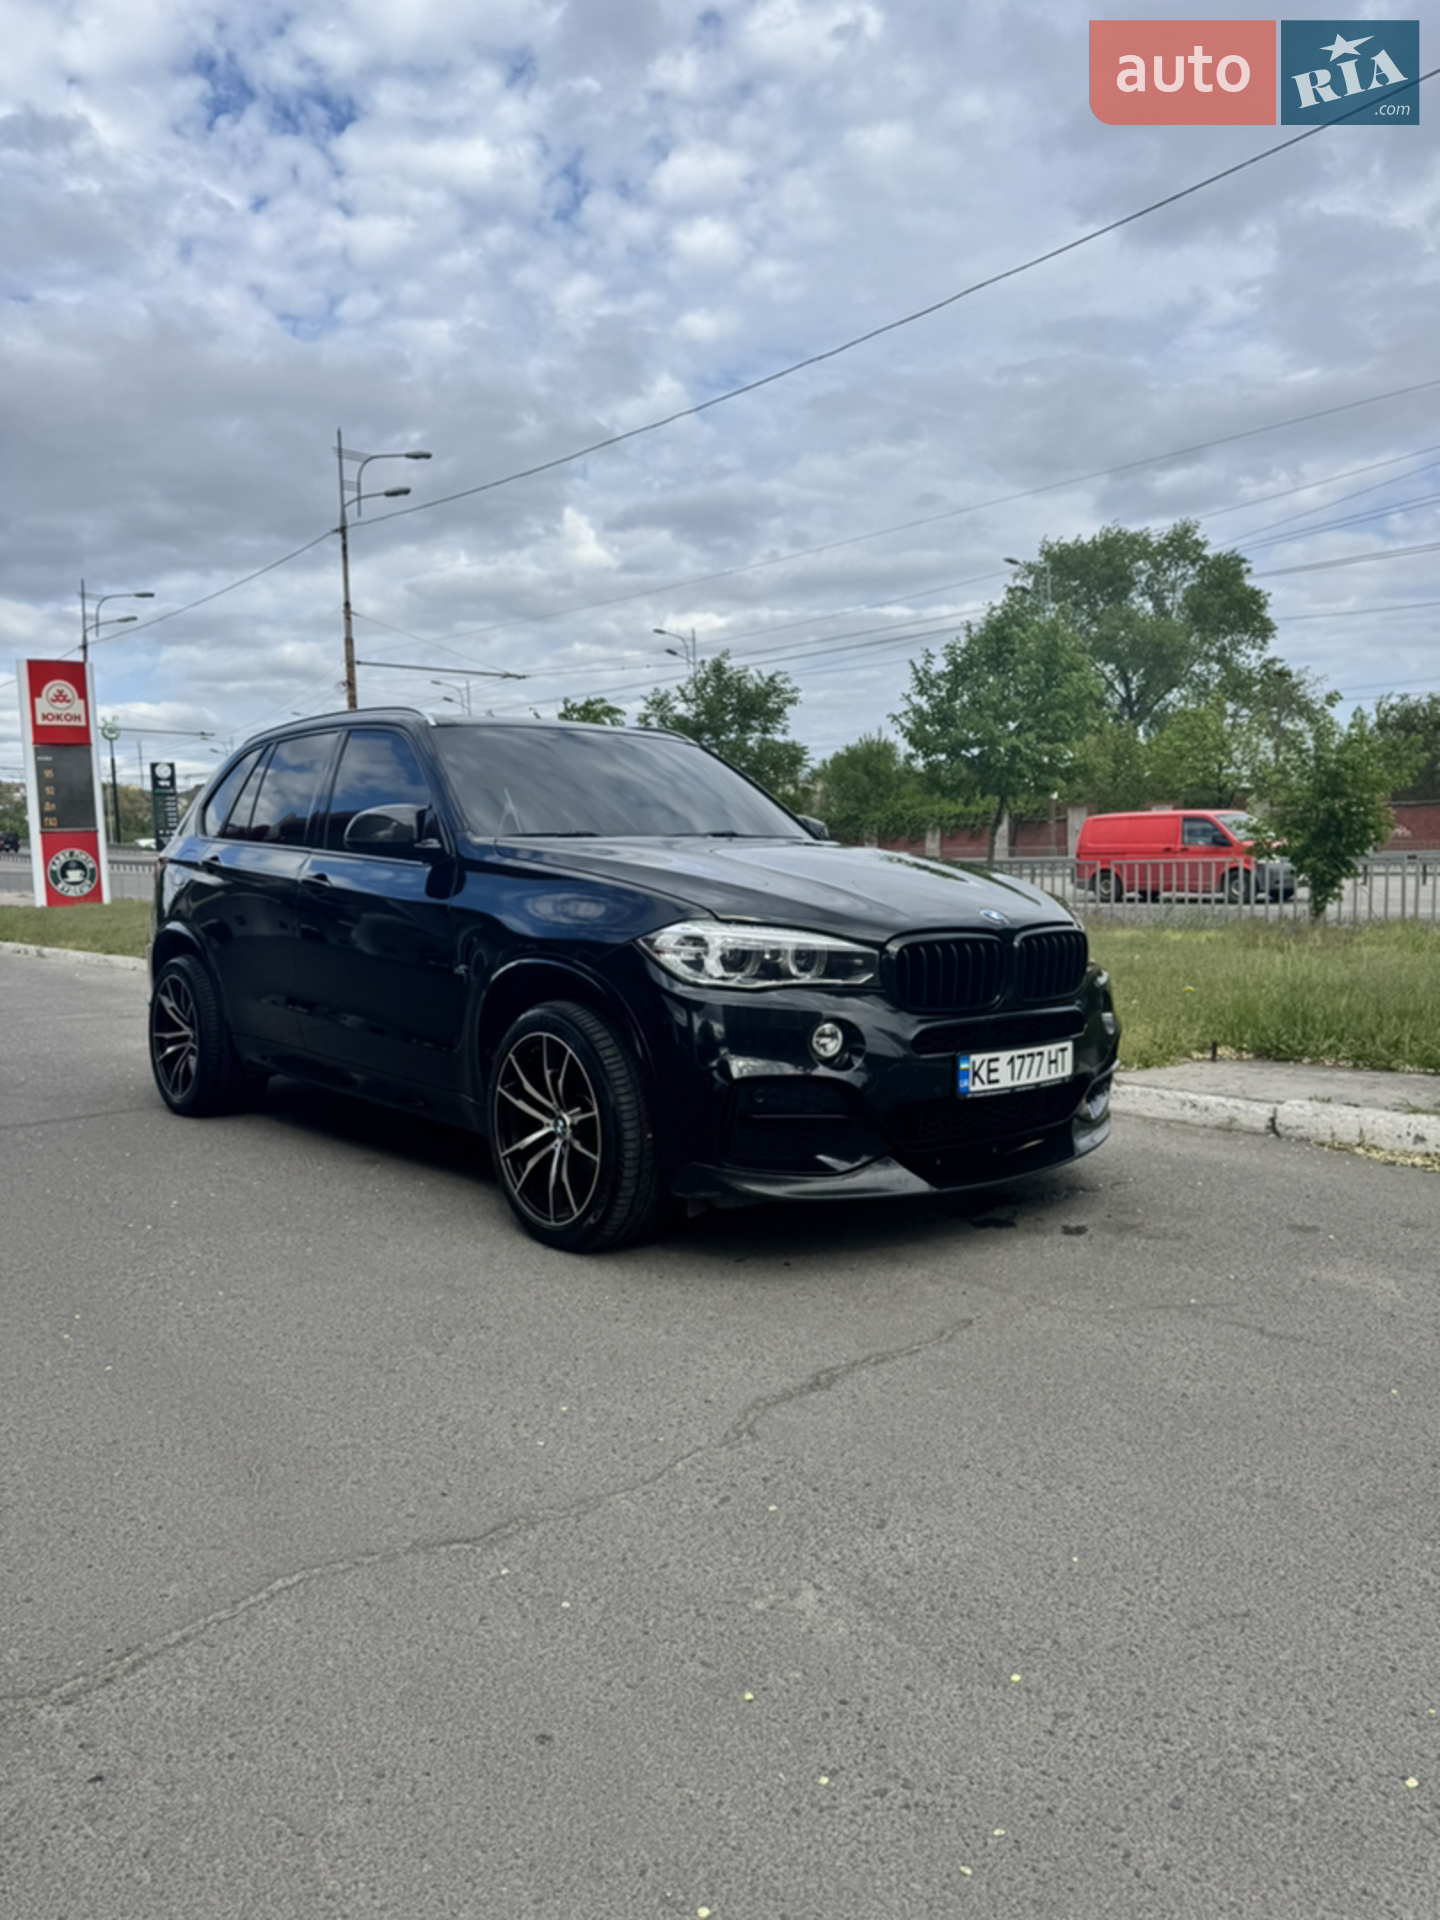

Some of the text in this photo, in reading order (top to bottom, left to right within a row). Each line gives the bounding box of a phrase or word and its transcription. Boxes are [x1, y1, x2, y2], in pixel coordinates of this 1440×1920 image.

[41, 712, 82, 722] ЮКОН
[971, 1057, 1000, 1087] KE
[1006, 1051, 1044, 1081] 1777
[1048, 1046, 1068, 1075] HT
